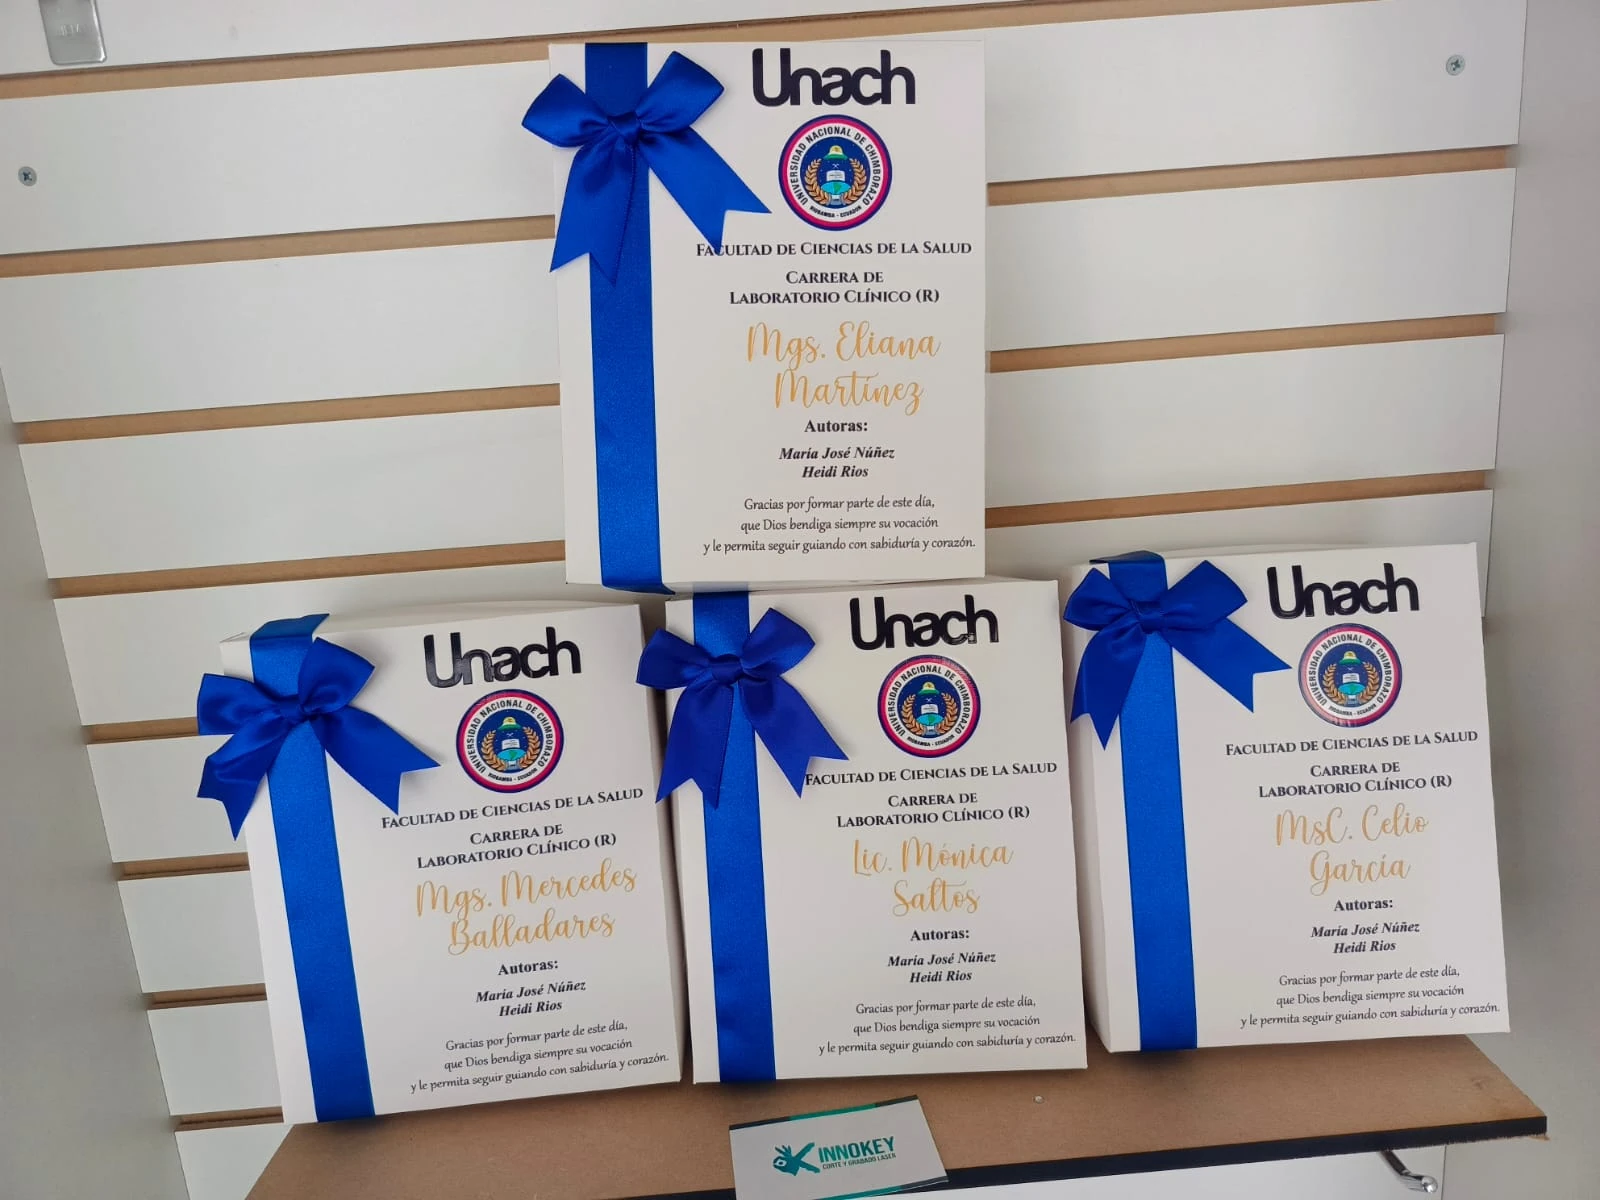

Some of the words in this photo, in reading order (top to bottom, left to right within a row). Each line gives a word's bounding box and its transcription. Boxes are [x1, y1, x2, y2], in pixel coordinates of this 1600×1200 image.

[752, 48, 916, 106] Unach
[790, 144, 808, 205] UNIVERSIDAD
[805, 126, 851, 143] NACIONAL
[854, 133, 866, 144] DE
[863, 144, 880, 205] CHIMBORAZO
[776, 244, 797, 255] DE
[801, 242, 872, 255] CIENCIAS
[877, 242, 898, 254] DE
[901, 242, 920, 254] LA
[923, 241, 972, 254] SALUD
[786, 271, 859, 284] CARRERA
[863, 272, 884, 283] DE
[730, 291, 840, 304] LABORATORIO
[844, 289, 912, 303] CLÍNICO
[915, 289, 939, 303] (R)
[747, 322, 826, 370] Mgs.
[836, 320, 942, 361] Eliana
[775, 368, 924, 416] Martínez
[804, 420, 867, 432] Autoras:
[778, 447, 819, 460] María
[821, 446, 851, 461] José
[852, 446, 895, 459] Núñez
[801, 464, 838, 478] Heidi
[840, 465, 869, 477] Rios
[744, 498, 784, 512] Gracias
[786, 501, 806, 514] por
[805, 496, 845, 514] formar
[846, 497, 874, 512] parte
[877, 495, 890, 508] de
[892, 497, 912, 507] este
[915, 494, 935, 508] día,
[741, 522, 760, 535] que
[762, 519, 787, 530] Dios
[789, 516, 832, 533] bendiga
[833, 518, 876, 532] siempre
[879, 520, 891, 529] su
[893, 516, 939, 528] vocación
[703, 544, 710, 556] y
[713, 538, 722, 551] le
[723, 540, 766, 556] permita
[768, 539, 801, 554] seguir
[802, 537, 846, 554] guiando
[849, 541, 868, 550] con
[870, 536, 921, 549] sabiduría
[922, 537, 930, 552] y
[930, 536, 976, 550] corazón.
[1267, 563, 1419, 619] Unach
[850, 595, 999, 650] Unach
[424, 627, 582, 688] Unach
[1309, 651, 1328, 705] UNIVERSIDAD
[1321, 634, 1362, 650] NACIONAL
[1365, 638, 1377, 649] DE
[1376, 648, 1392, 703] CHIMBORAZO
[888, 681, 906, 736] UNIVERSIDAD
[901, 665, 942, 681] NACIONAL
[944, 670, 956, 680] DE
[955, 680, 970, 734] CHIMBORAZO
[1226, 744, 1296, 756] FACULTAD
[1300, 740, 1319, 752] DE
[1323, 736, 1389, 751] CIENCIAS
[1392, 735, 1411, 746] DE
[1414, 734, 1432, 745] LA
[1434, 731, 1478, 744] SALUD
[805, 772, 875, 786] FACULTAD
[878, 771, 897, 782] DE
[900, 767, 966, 779] CIENCIAS
[970, 766, 989, 777] DE
[992, 765, 1010, 776] LA
[1012, 762, 1057, 774] SALUD
[1310, 763, 1378, 777] CARRERA
[1380, 762, 1400, 773] DE
[1259, 782, 1361, 798] LABORATORIO
[1365, 777, 1427, 791] CLÍNICO
[1430, 775, 1452, 789] (R)
[381, 812, 455, 829] FACULTAD
[459, 808, 479, 820] DE
[482, 800, 551, 817] CIENCIAS
[554, 797, 574, 808] DE
[577, 795, 595, 806] LA
[598, 788, 643, 803] SALUD
[888, 794, 955, 808] CARRERA
[958, 792, 978, 804] DE
[836, 812, 939, 828] LABORATORIO
[942, 808, 1004, 823] CLÍNICO
[1008, 806, 1030, 820] (R)
[1276, 807, 1352, 846] MsC.
[1362, 802, 1429, 841] Celio
[470, 827, 540, 845] CARRERA
[544, 824, 563, 836] DE
[417, 846, 523, 869] LABORATORIO
[527, 837, 590, 856] CLÍNICO
[594, 833, 616, 848] (R)
[852, 839, 893, 877] Lic.
[902, 836, 1014, 873] Mónica
[1310, 850, 1411, 896] García
[416, 880, 493, 920] Mgs.
[502, 858, 637, 907] Mercedes
[893, 878, 981, 917] Saltos
[1333, 899, 1393, 911] Autoras:
[448, 907, 616, 956] Balladares
[910, 930, 970, 942] Autoras:
[1310, 925, 1348, 937] María
[1351, 923, 1379, 936] José
[1381, 921, 1420, 933] Núñez
[927, 953, 955, 965] José
[957, 952, 996, 963] Núñez
[1332, 941, 1367, 954] Heidi
[1369, 940, 1397, 952] Rios
[498, 960, 558, 975] Autoras:
[909, 971, 943, 983] Heidi
[945, 970, 972, 982] Rios
[1279, 975, 1317, 986] Gracias
[1320, 976, 1337, 987] por
[1337, 970, 1374, 986] formar
[1376, 969, 1403, 984] parte
[1405, 967, 1418, 979] de
[1420, 968, 1439, 978] este
[1441, 964, 1460, 977] día,
[516, 984, 544, 998] José
[547, 981, 586, 994] Núñez
[1276, 997, 1295, 1008] que
[1297, 993, 1320, 1004] Dios
[1323, 989, 1364, 1005] bendiga
[1366, 990, 1406, 1003] siempre
[1408, 990, 1420, 999] su
[1421, 984, 1464, 997] vocación
[499, 1002, 532, 1016] Heidi
[535, 1000, 562, 1012] Rios
[856, 1003, 893, 1014] Gracias
[896, 1004, 914, 1016] por
[913, 1000, 951, 1016] formar
[952, 1000, 978, 1014] parte
[981, 996, 993, 1008] de
[996, 997, 1015, 1008] este
[1017, 994, 1036, 1008] día,
[446, 1039, 484, 1050] Gracias
[486, 1038, 504, 1050] por
[504, 1032, 542, 1049] formar
[544, 1028, 570, 1044] parte
[572, 1024, 585, 1036] de
[587, 1024, 607, 1034] este
[609, 1019, 627, 1031] día,
[818, 1136, 894, 1163] INNOKEY
